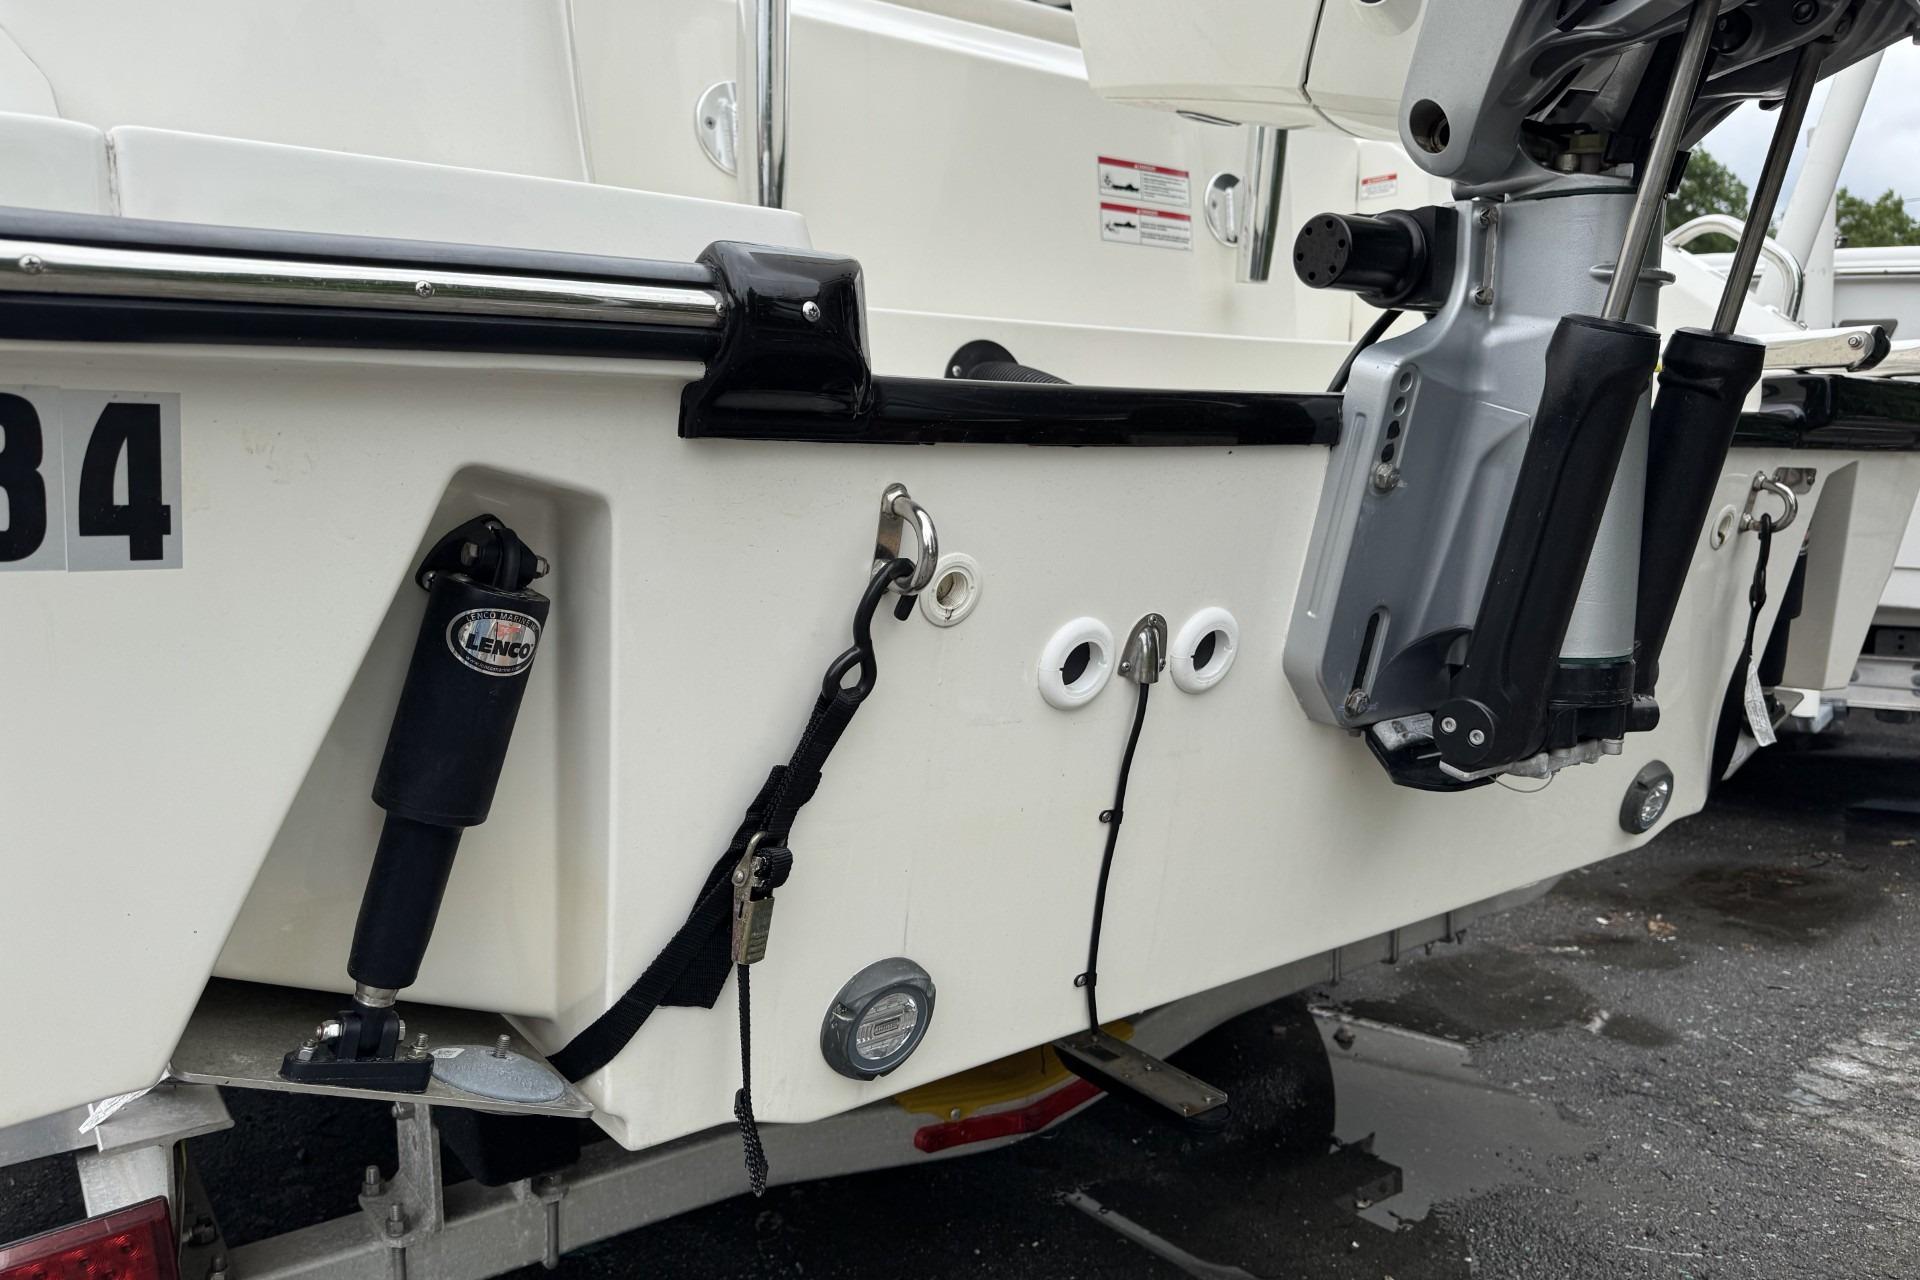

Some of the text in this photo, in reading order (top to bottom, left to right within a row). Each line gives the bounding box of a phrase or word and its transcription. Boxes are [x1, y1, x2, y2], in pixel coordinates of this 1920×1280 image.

[466, 612, 496, 622] LENCO
[499, 613, 532, 627] MARINE
[465, 633, 531, 659] LENCO
